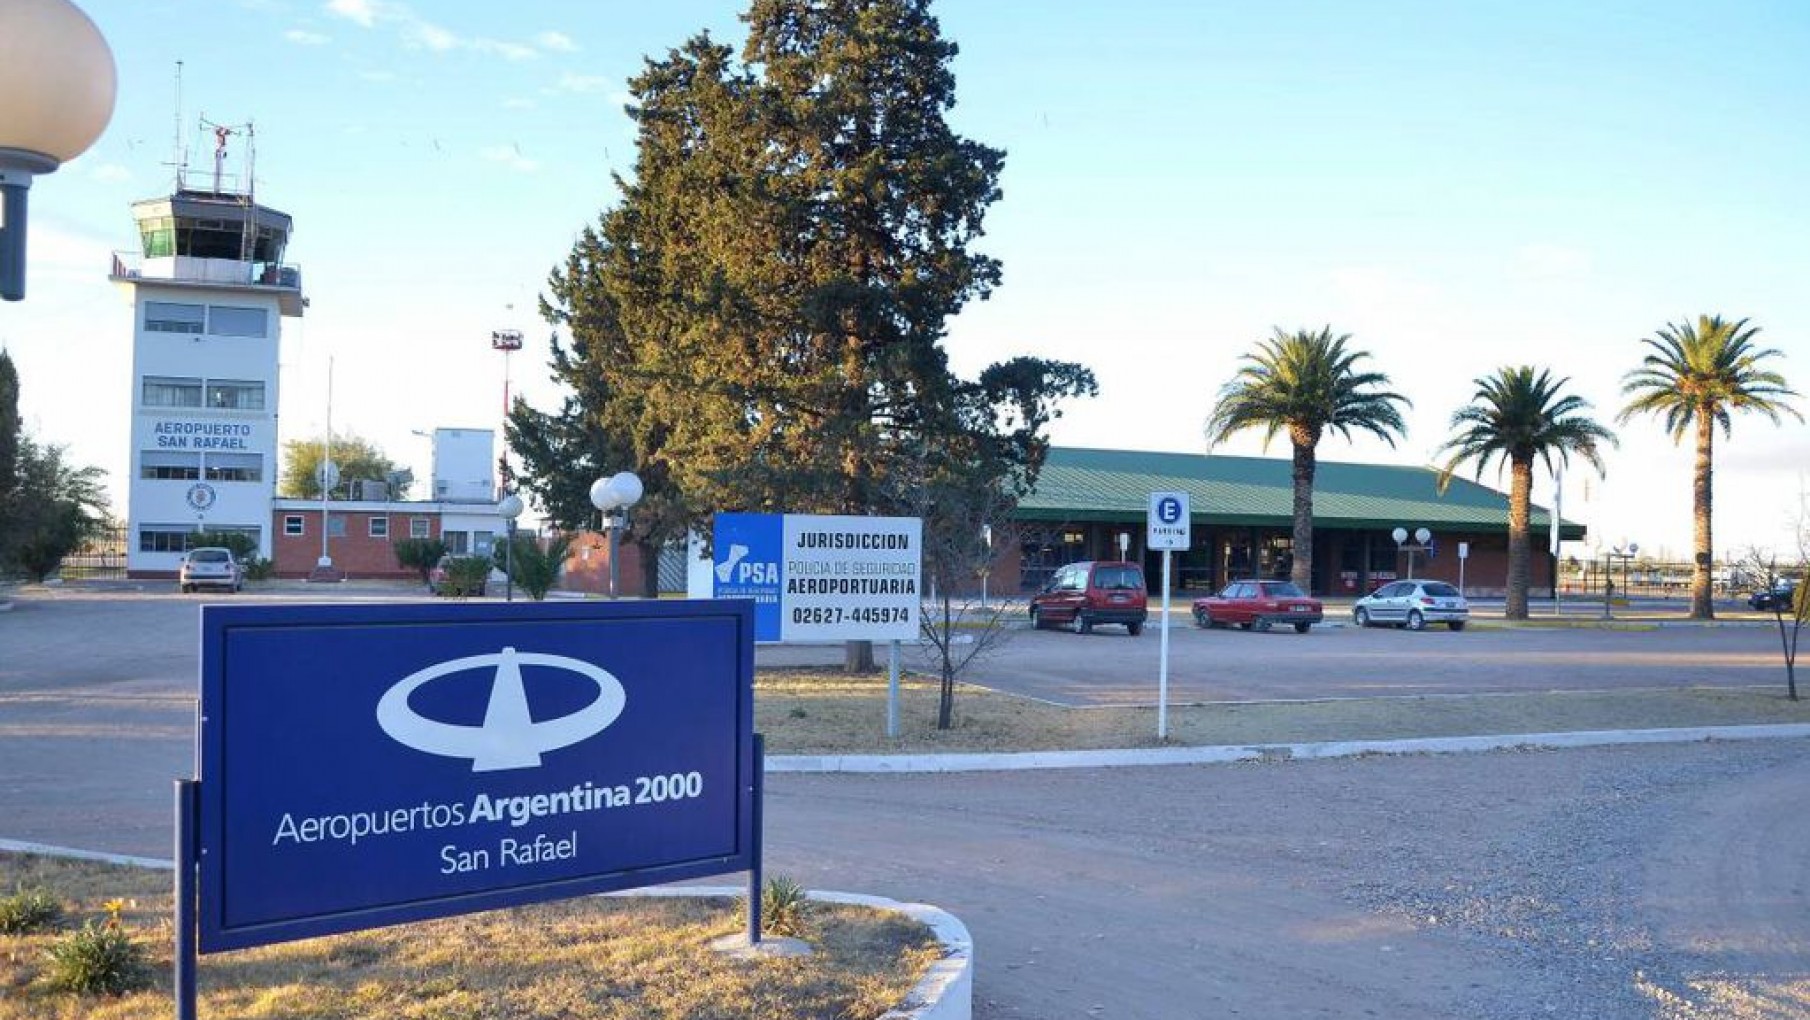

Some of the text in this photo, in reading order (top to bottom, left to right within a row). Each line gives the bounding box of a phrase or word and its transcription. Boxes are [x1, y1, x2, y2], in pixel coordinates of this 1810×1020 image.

[155, 423, 250, 436] AEROPUERTO
[158, 436, 247, 449] SAN RAFAEL
[1164, 502, 1175, 519] E
[797, 532, 909, 550] JURISDICCION
[740, 563, 778, 584] PSA
[788, 561, 916, 576] POLICIA DE SEGURIDAD
[787, 578, 916, 594] AEROPORTUARIA
[793, 607, 909, 624] 02627-445974
[273, 771, 703, 845] Aeropuertos Argentina 2000
[440, 830, 577, 874] San Rafael
